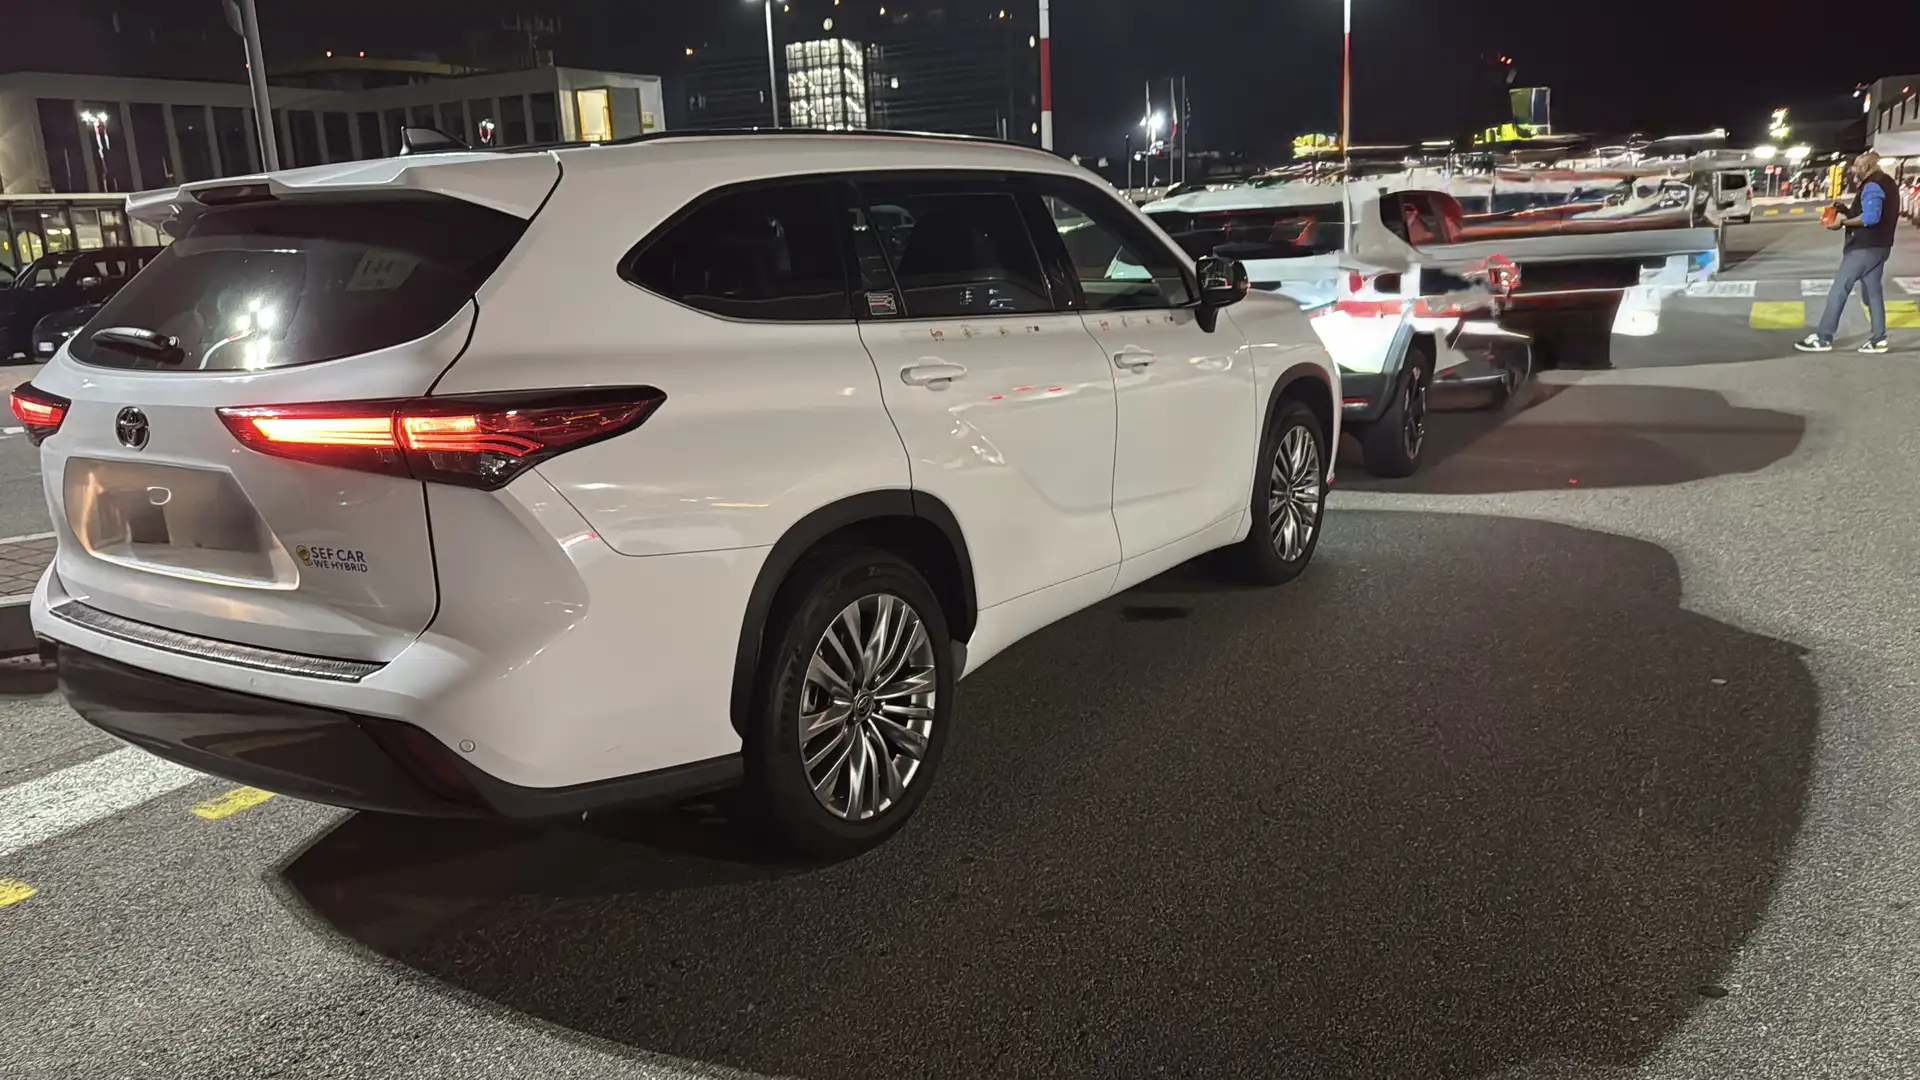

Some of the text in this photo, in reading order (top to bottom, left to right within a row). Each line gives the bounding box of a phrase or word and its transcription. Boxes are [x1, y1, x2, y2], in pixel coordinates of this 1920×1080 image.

[311, 547, 366, 563] SEF CAR
[313, 560, 368, 573] WE HYBRID
